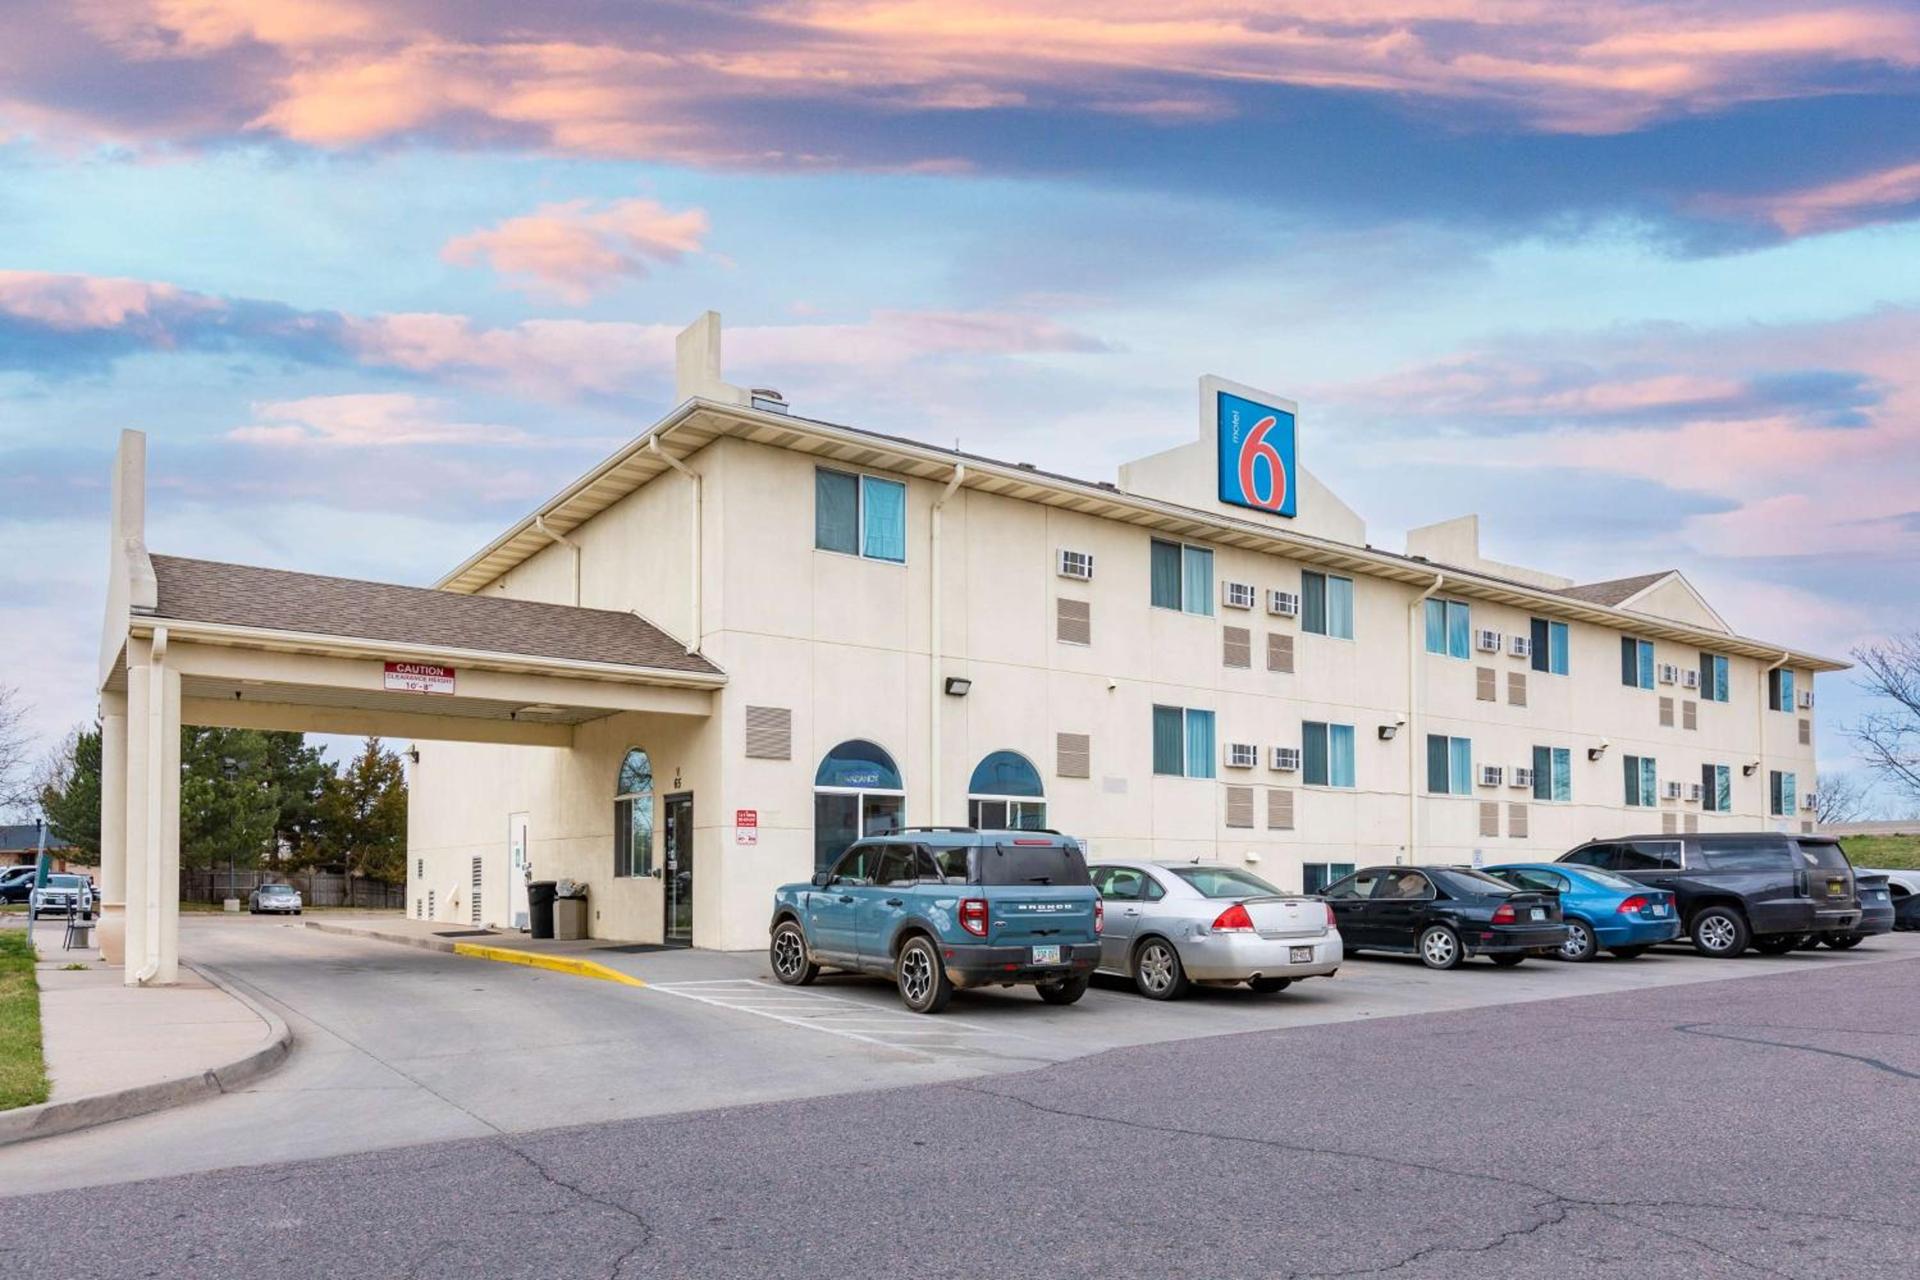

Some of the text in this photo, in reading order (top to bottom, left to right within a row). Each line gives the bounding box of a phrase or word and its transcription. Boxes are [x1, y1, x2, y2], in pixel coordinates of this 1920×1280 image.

[1231, 410, 1240, 444] motel
[1238, 416, 1287, 511] 6
[396, 663, 444, 676] CAUTION
